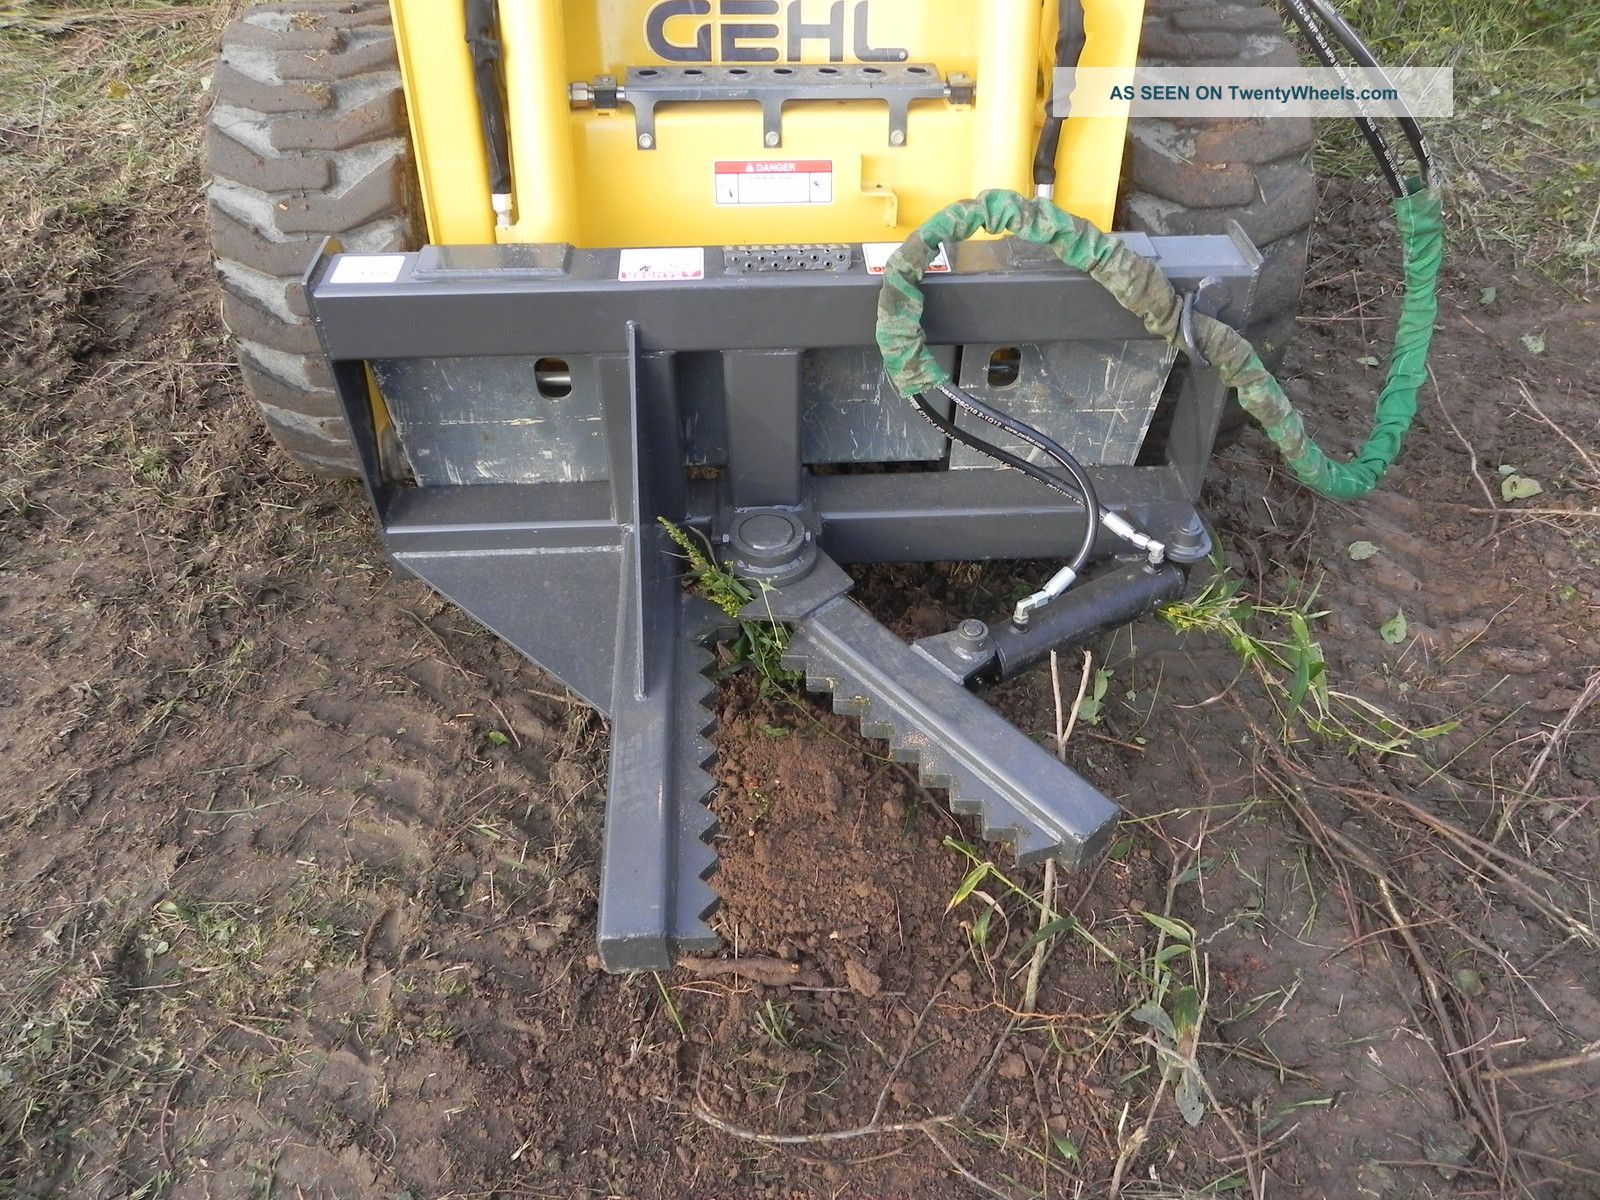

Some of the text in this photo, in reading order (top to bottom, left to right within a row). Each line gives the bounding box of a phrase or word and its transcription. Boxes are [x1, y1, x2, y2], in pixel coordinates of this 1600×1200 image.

[646, 0, 909, 62] GEHL
[1307, 19, 1319, 33] WP
[1324, 46, 1336, 64] MPa
[756, 163, 796, 172] DANGER
[1005, 425, 1047, 450] www.parker.com
